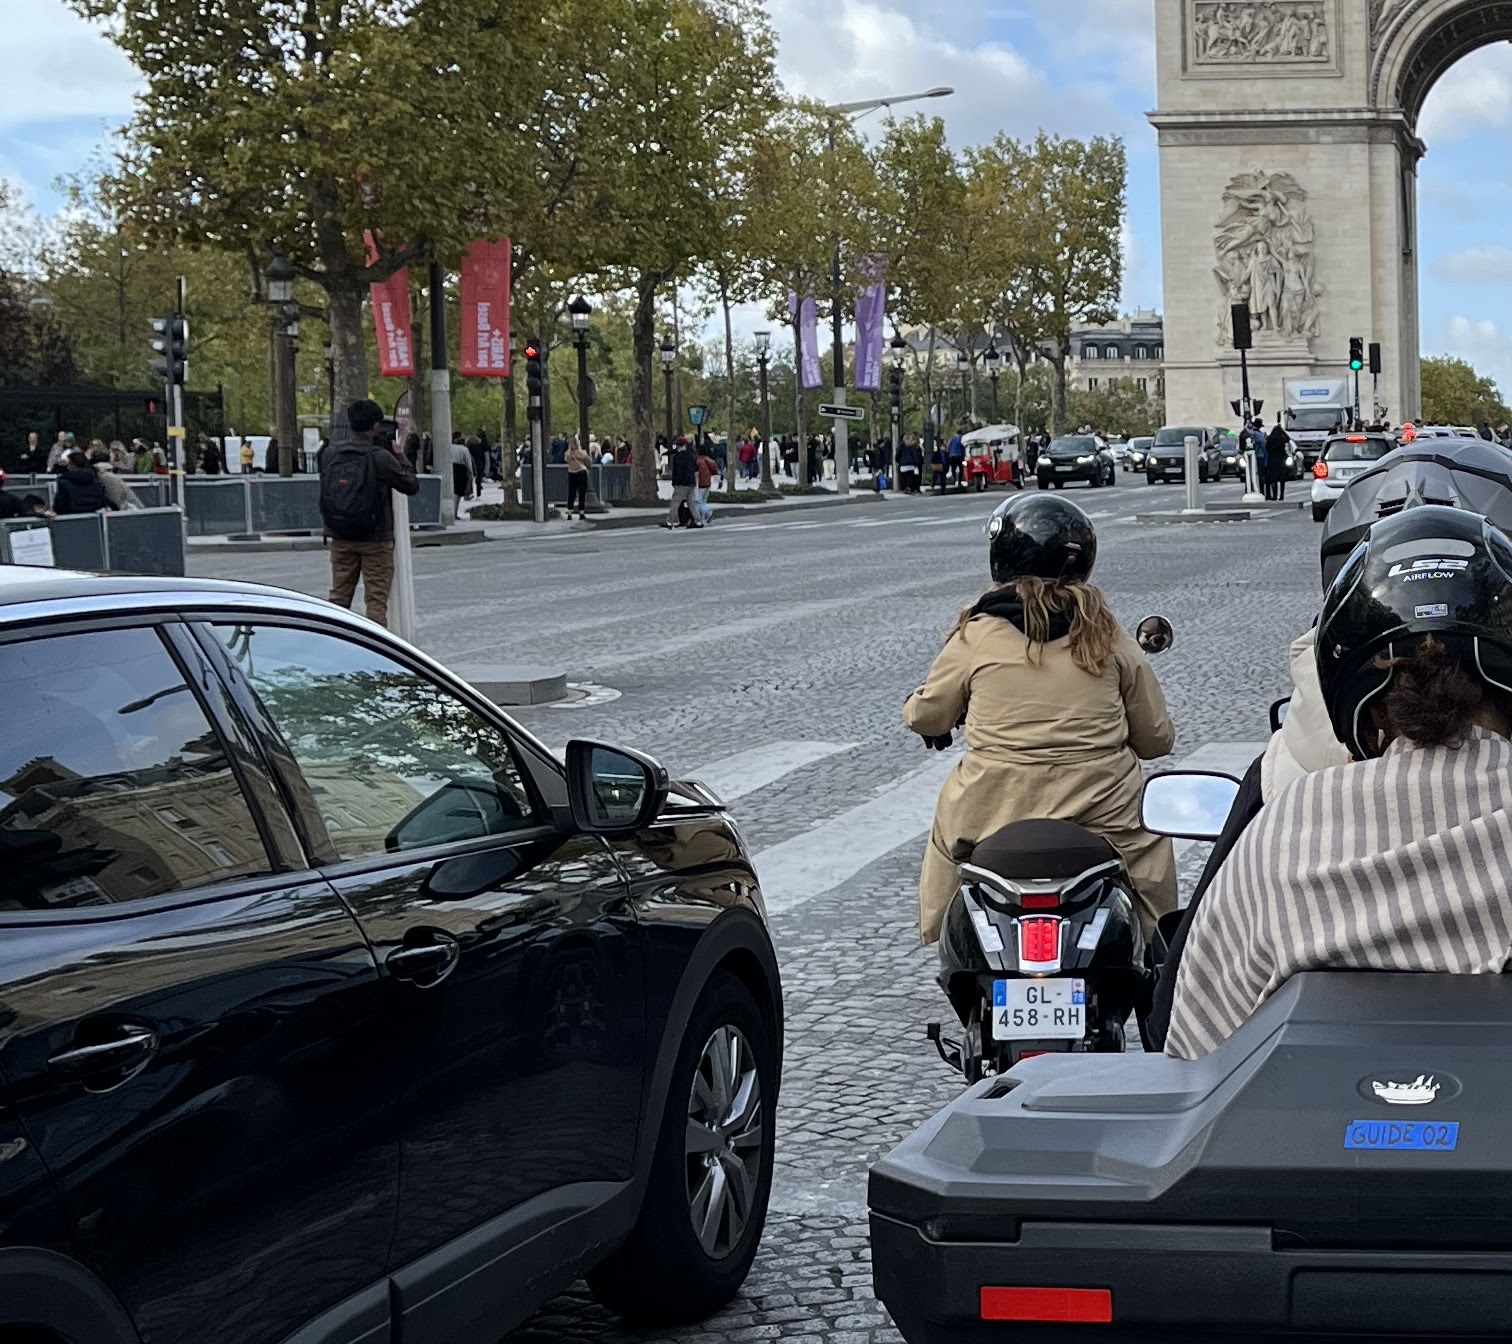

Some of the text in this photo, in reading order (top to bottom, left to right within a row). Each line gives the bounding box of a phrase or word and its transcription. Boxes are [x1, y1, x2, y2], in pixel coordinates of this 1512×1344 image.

[1388, 558, 1469, 577] LS2
[1403, 571, 1455, 583] AIRFLOW
[1351, 1124, 1452, 1146] GUIDE 02
